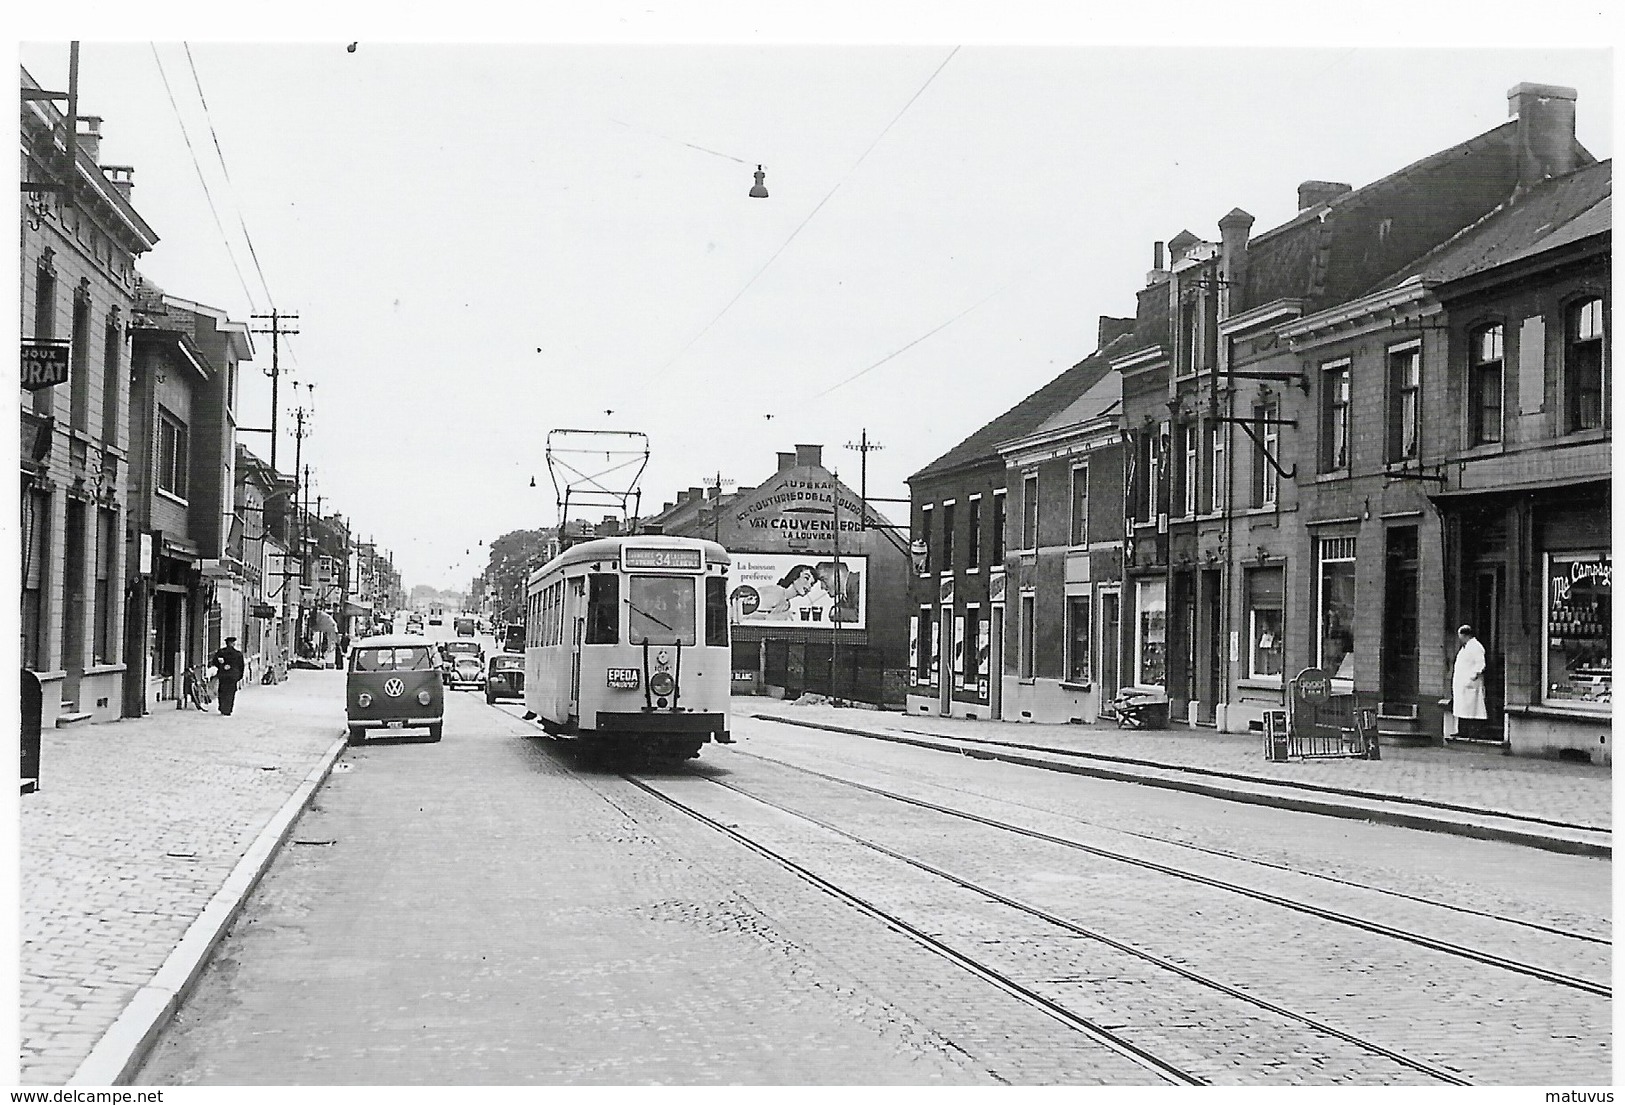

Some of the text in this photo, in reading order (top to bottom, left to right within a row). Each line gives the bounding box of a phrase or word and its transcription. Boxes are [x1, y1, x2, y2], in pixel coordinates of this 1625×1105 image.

[819, 493, 832, 503] LA
[749, 519, 768, 529] VAN
[655, 553, 671, 566] 34
[737, 561, 776, 571] La boisson
[608, 669, 638, 681] EPEDA
